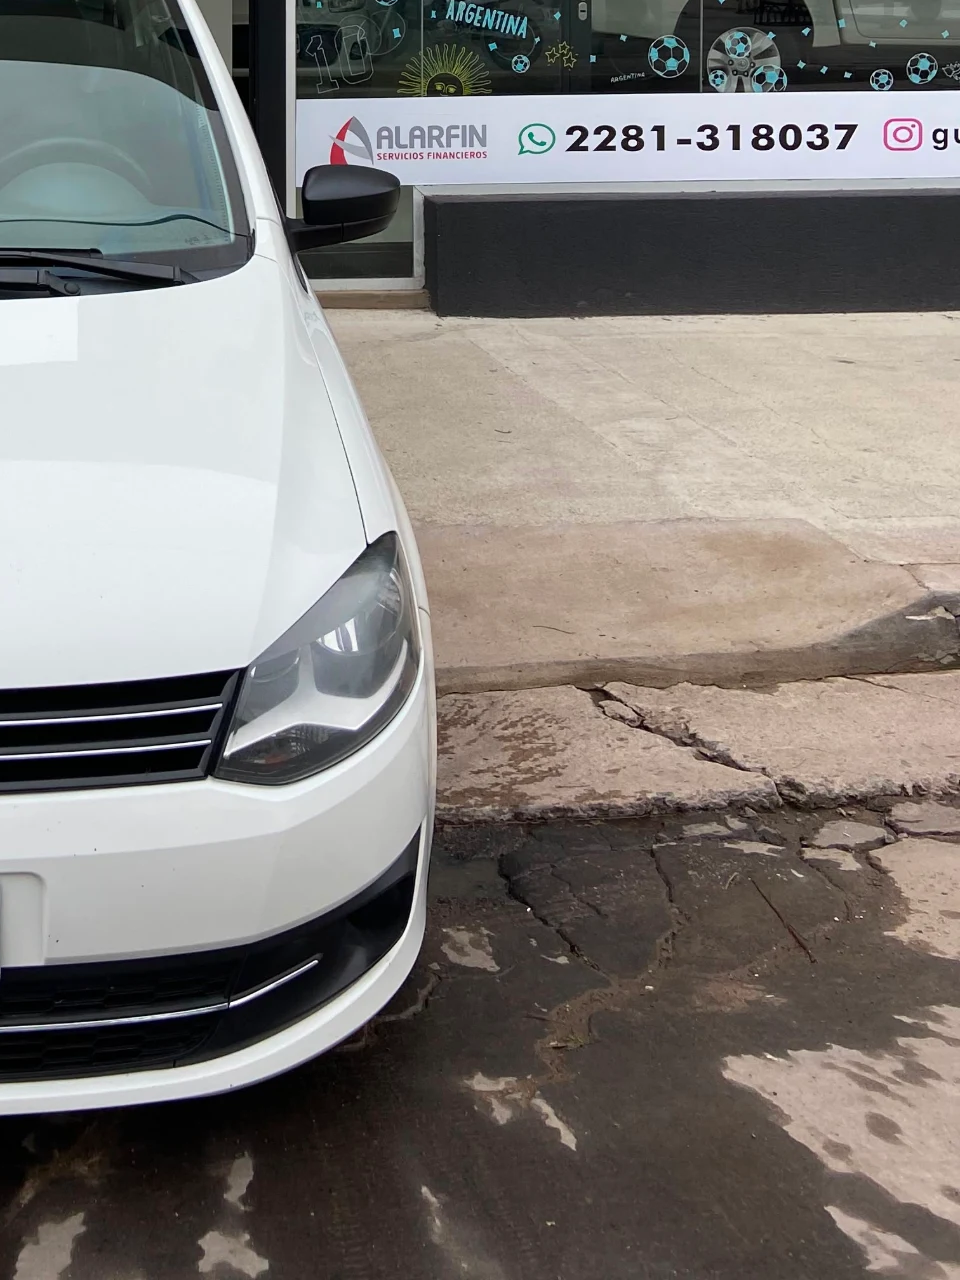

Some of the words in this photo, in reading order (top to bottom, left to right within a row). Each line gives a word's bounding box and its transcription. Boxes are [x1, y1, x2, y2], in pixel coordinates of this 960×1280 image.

[306, 24, 374, 94] 10
[610, 71, 646, 83] ARGENTINA
[376, 124, 487, 150] ALARFIN
[564, 123, 859, 153] 2281-318037
[376, 152, 424, 161] SERVICIOS
[427, 150, 488, 160] FINANCIEROS
